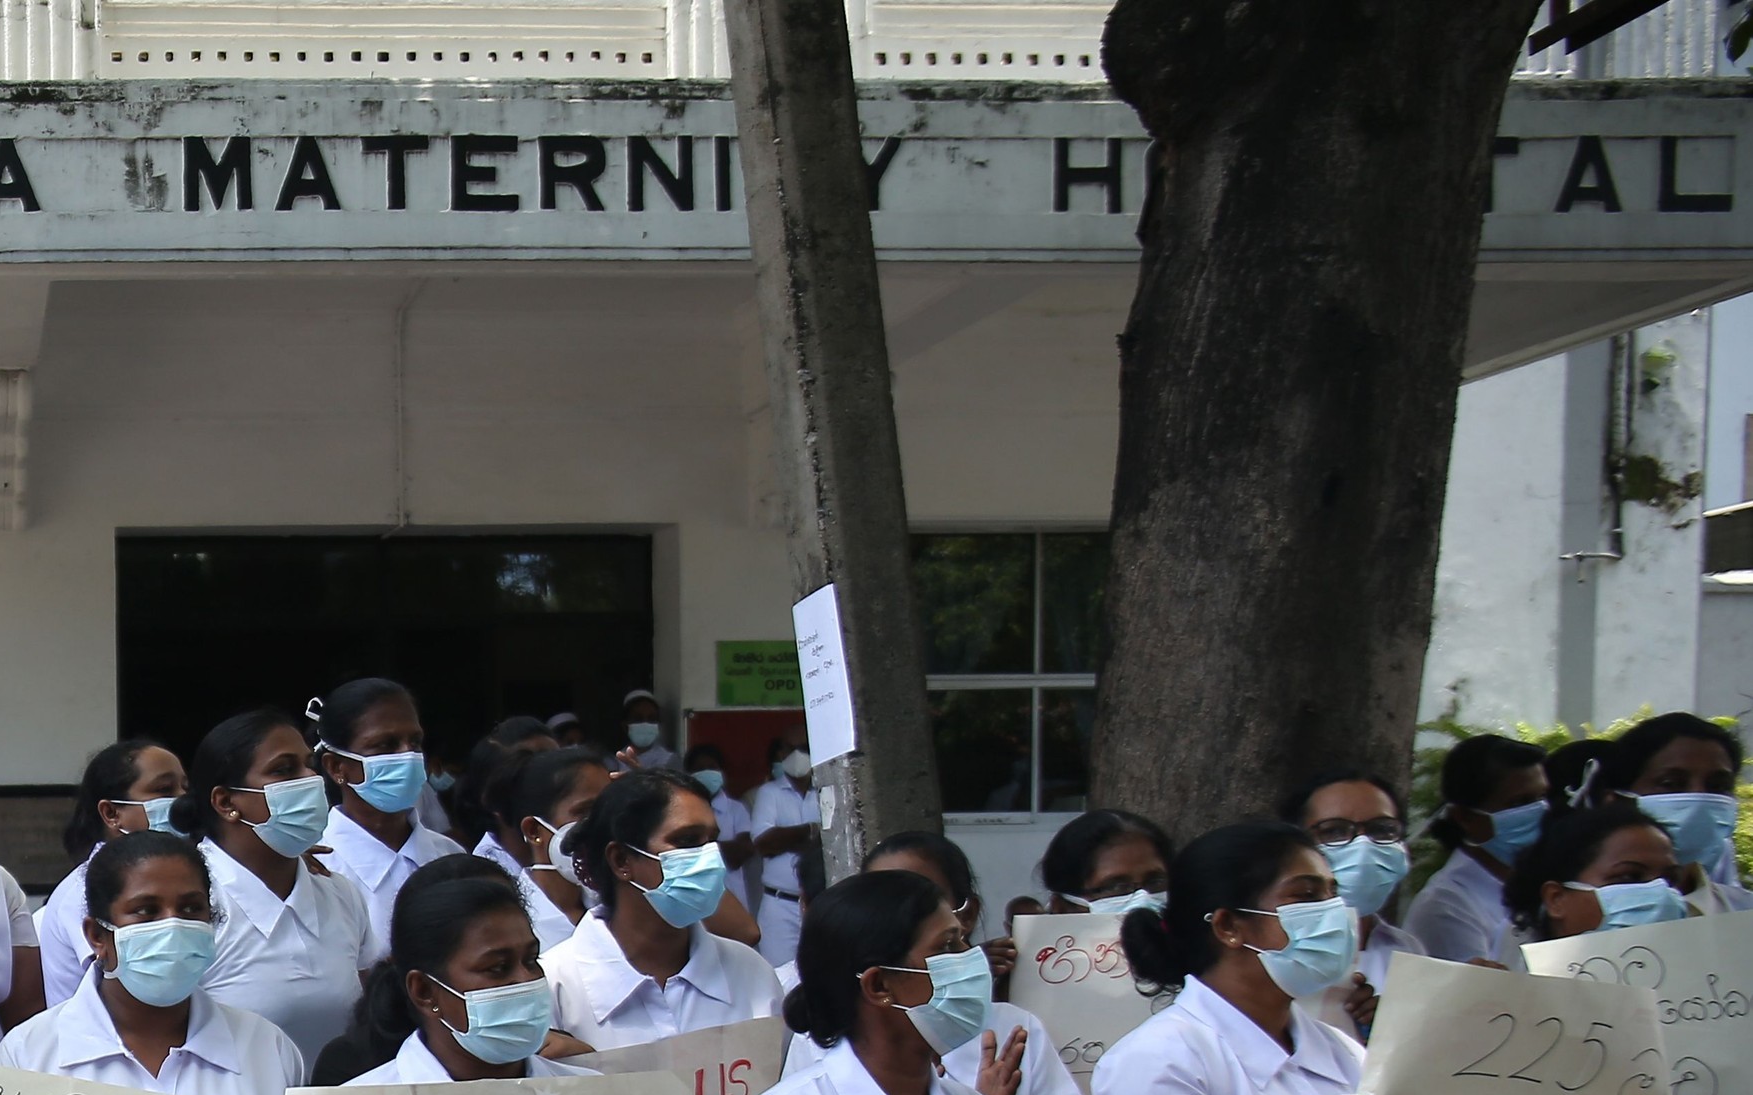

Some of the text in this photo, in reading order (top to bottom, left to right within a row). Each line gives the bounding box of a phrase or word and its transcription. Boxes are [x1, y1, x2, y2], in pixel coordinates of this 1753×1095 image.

[181, 133, 904, 213] MATERNIY
[764, 679, 797, 691] OPD
[1451, 1012, 1614, 1092] 225
